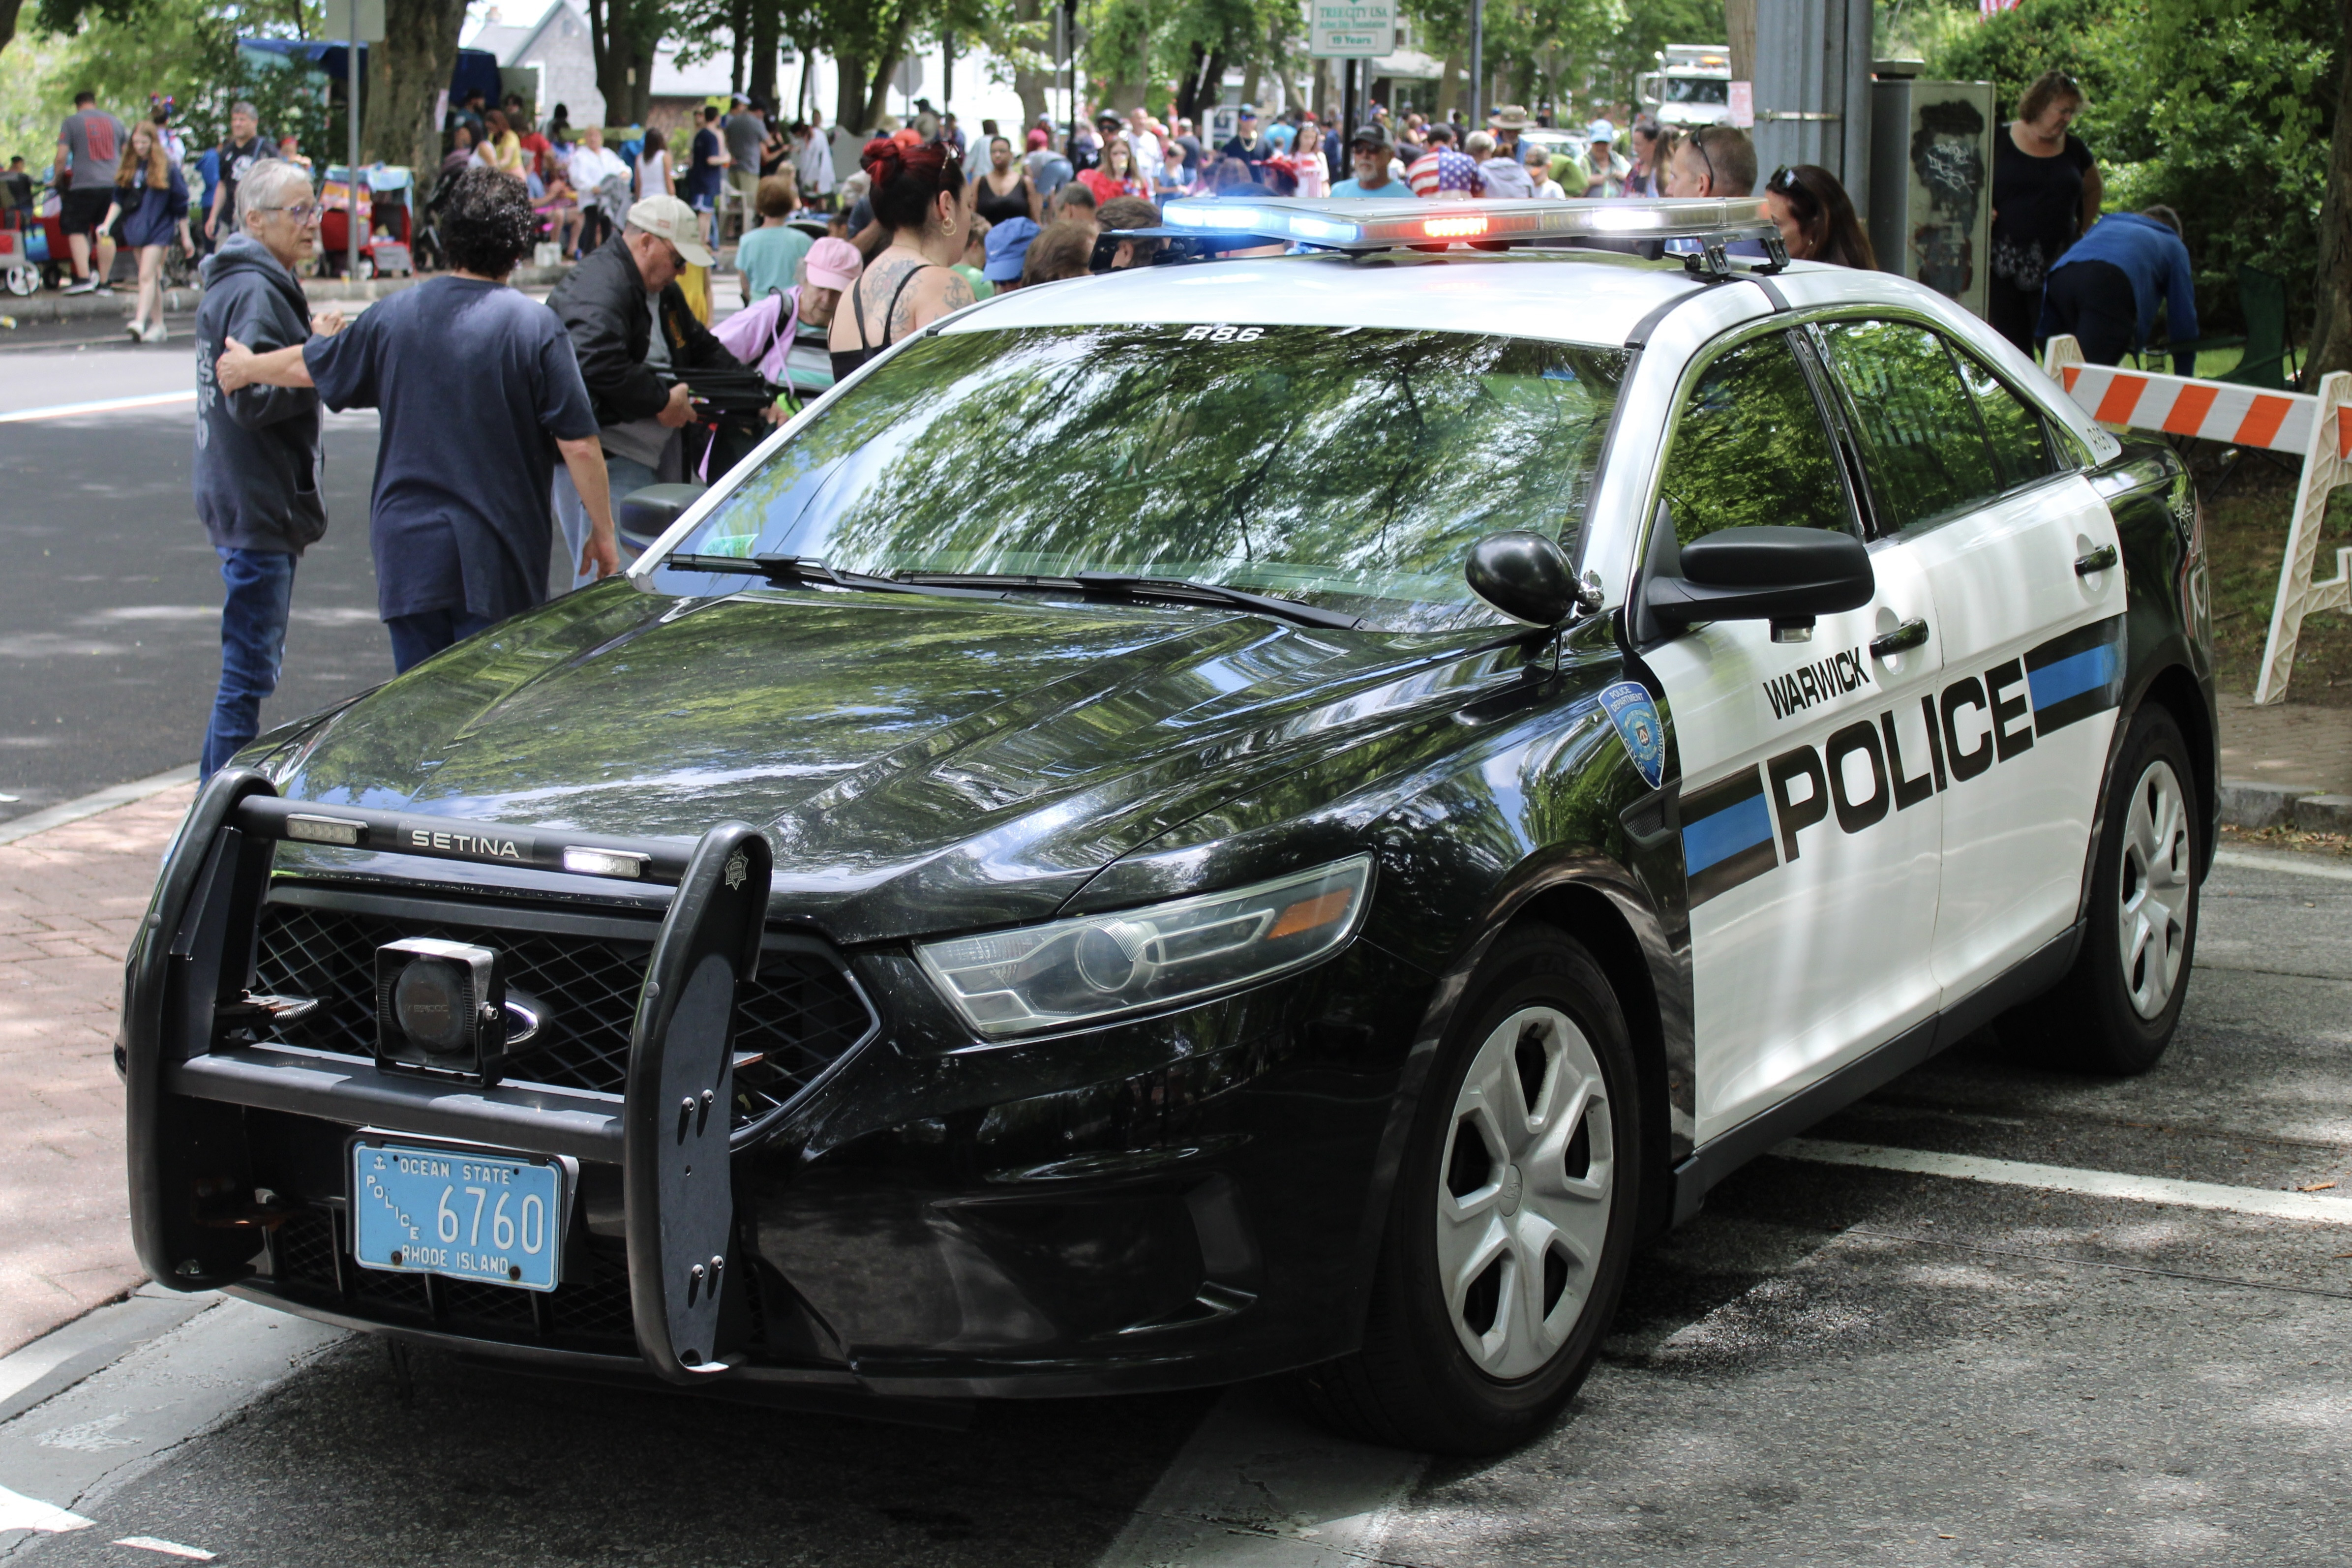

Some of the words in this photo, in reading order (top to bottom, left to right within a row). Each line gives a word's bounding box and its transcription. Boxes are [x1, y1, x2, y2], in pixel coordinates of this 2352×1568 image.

[1319, 7, 1343, 18] TREE
[1345, 6, 1366, 18] CITY
[1370, 7, 1387, 18] USA
[1332, 35, 1342, 44] 19
[1345, 35, 1372, 44] Years
[1179, 325, 1265, 343] R86
[2086, 427, 2112, 452] R86
[1609, 686, 1632, 699] POLICE
[1762, 646, 1870, 720] WARWICK
[1610, 693, 1644, 712] DEPARTMENT
[1624, 738, 1637, 759] CITY
[1638, 761, 1646, 773] OF
[1655, 717, 1663, 767] WARWICK
[1767, 657, 2034, 864] POLICE
[412, 829, 520, 859] SETINA
[399, 1157, 451, 1178] OCEAN
[462, 1164, 511, 1185] STATE
[366, 1175, 421, 1241] POLICE
[437, 1184, 544, 1255] 6760
[401, 1244, 449, 1267] RHODE
[456, 1251, 509, 1275] ISLAND
